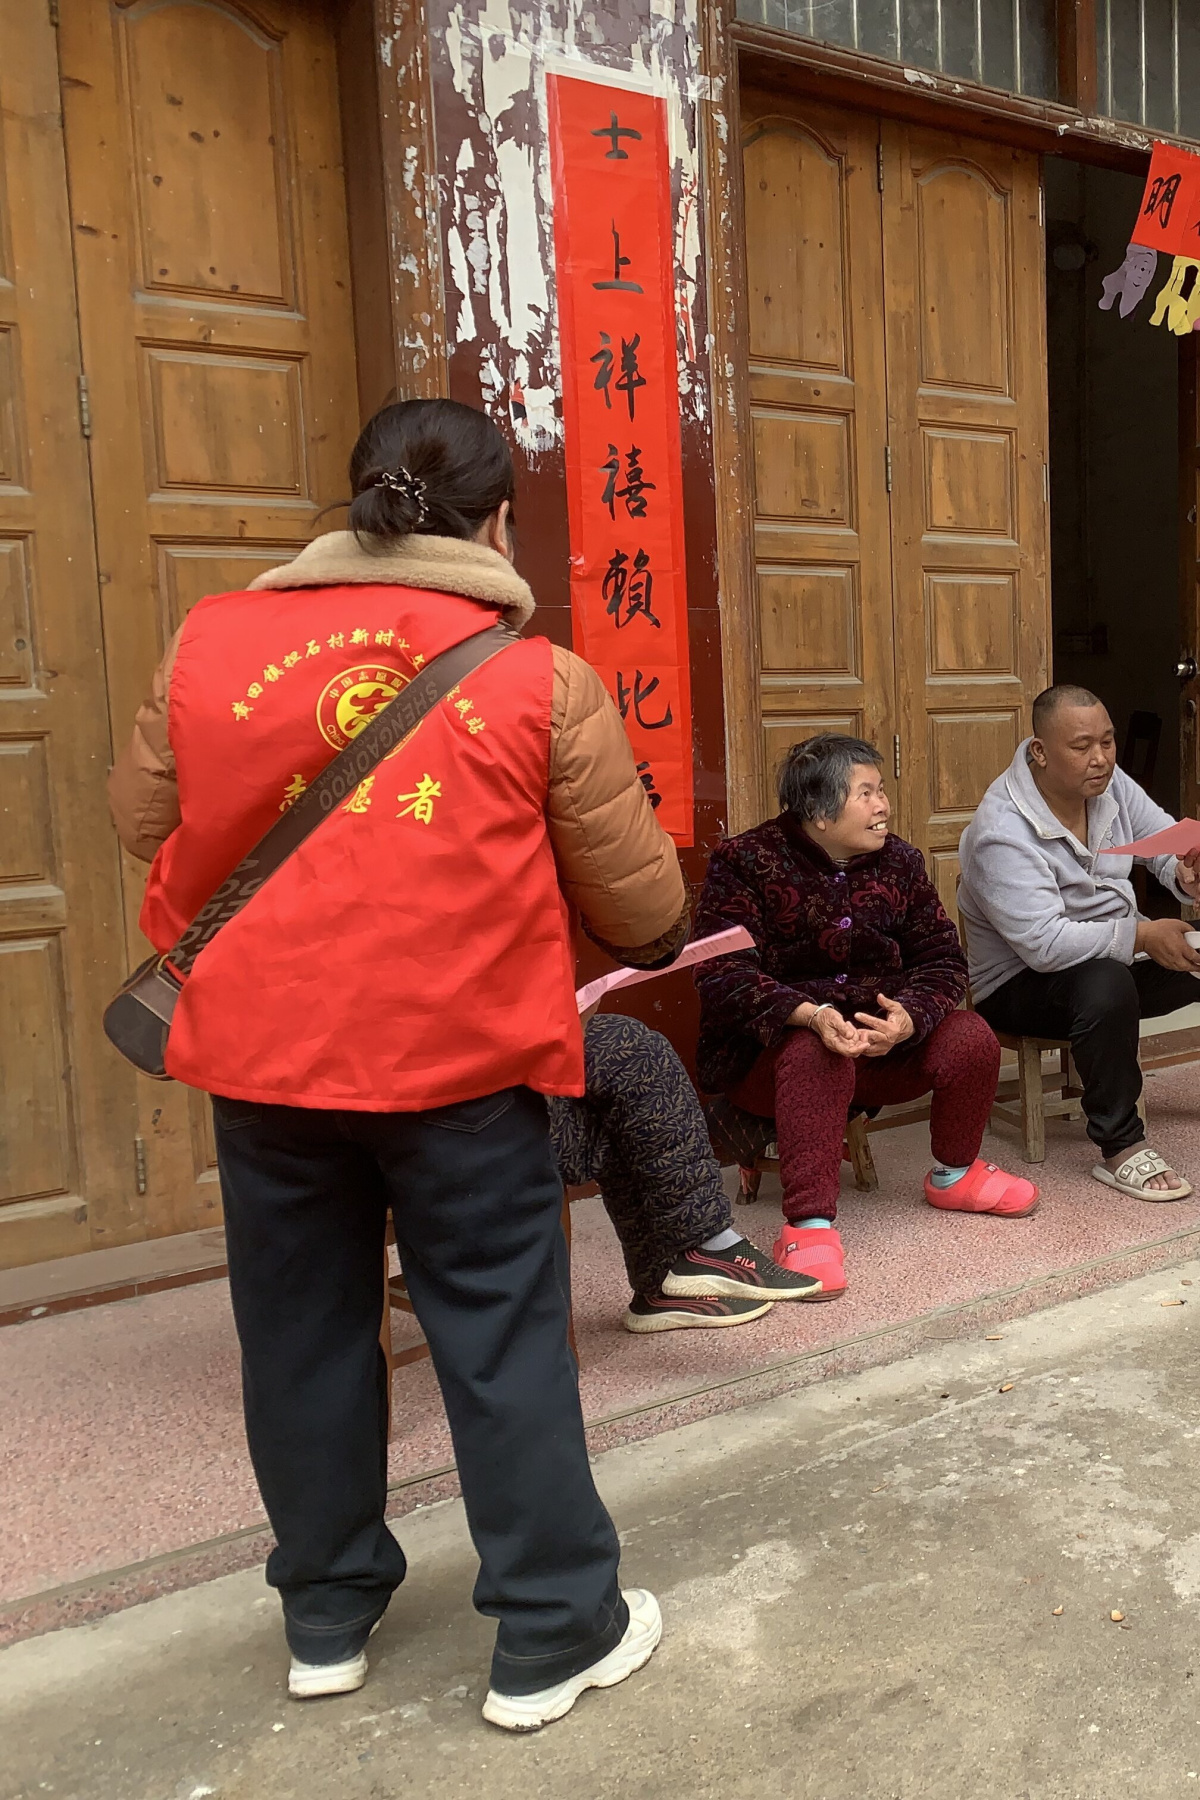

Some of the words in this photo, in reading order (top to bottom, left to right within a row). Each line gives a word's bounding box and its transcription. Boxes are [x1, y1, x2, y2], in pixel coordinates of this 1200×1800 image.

[329, 671, 403, 699] 中国志愿服
[326, 724, 345, 745] China
[734, 1255, 756, 1270] FILA
